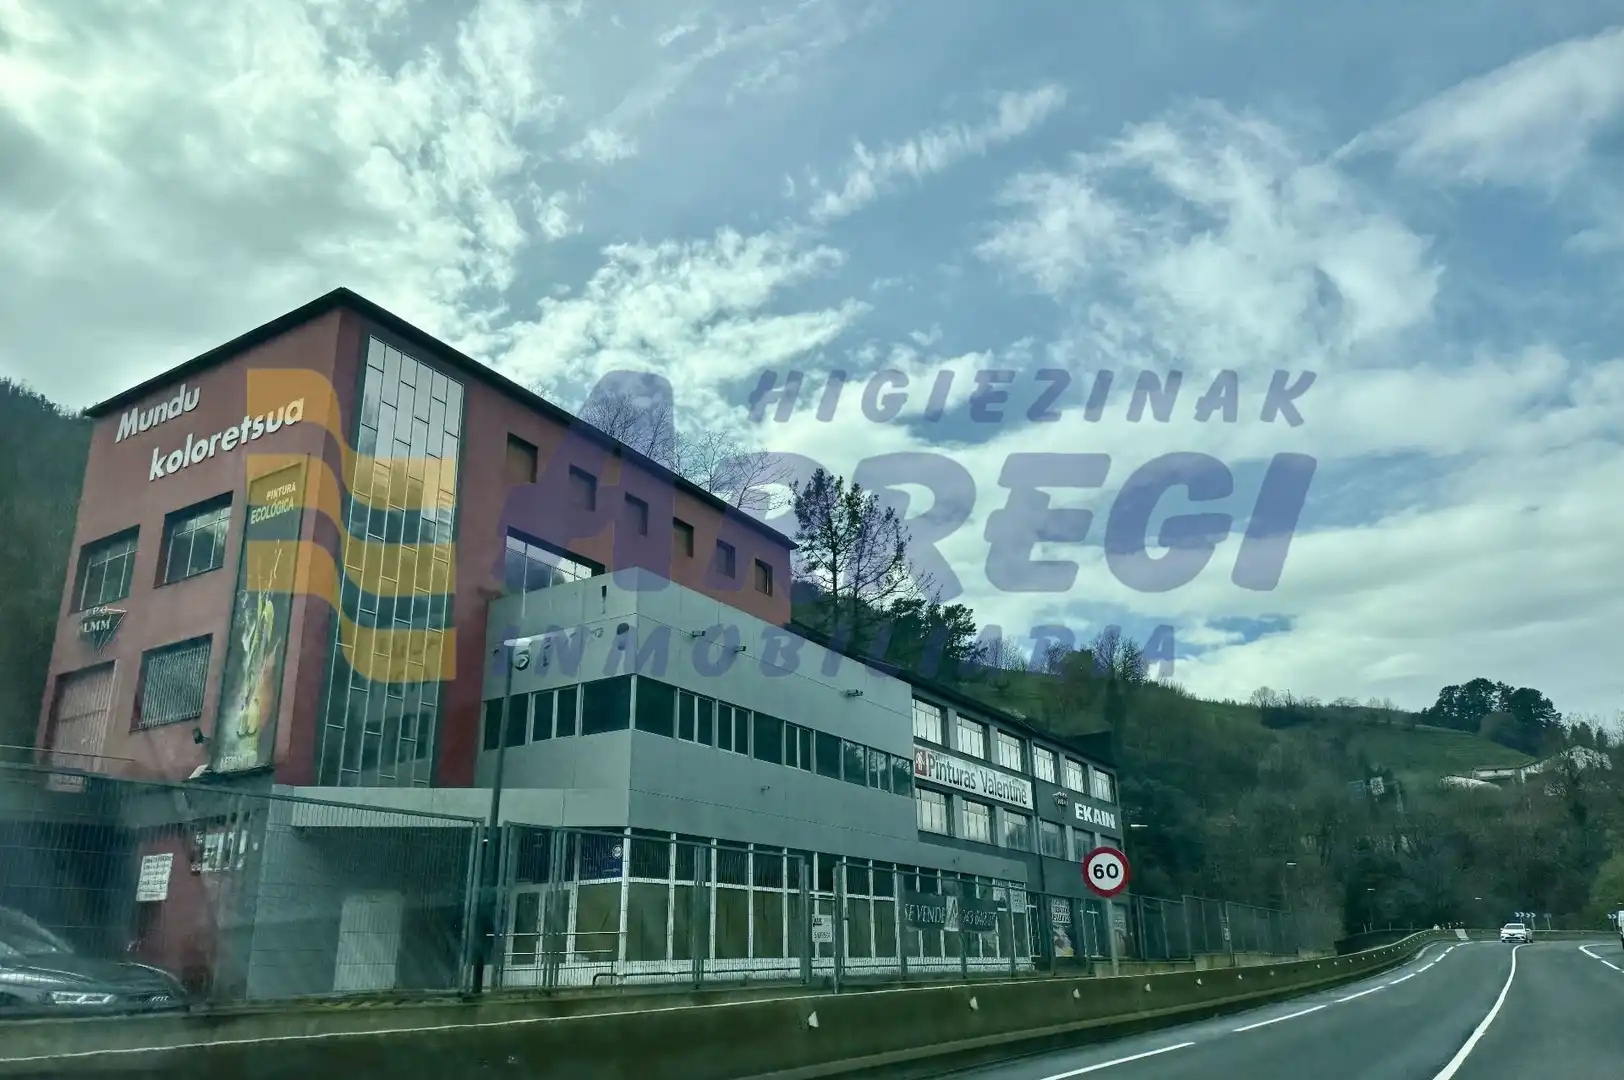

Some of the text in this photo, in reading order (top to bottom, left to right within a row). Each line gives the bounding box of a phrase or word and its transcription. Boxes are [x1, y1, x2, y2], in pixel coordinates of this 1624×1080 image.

[115, 384, 200, 443] Mundu
[149, 398, 304, 481] koloretsua
[266, 481, 296, 501] PINTURA
[250, 497, 294, 524] ECOLÓGICA
[928, 750, 1027, 805] Pinturas Valentine
[1075, 802, 1116, 830] EKAIN
[1093, 863, 1119, 879] 60
[916, 904, 946, 924] VENDE
